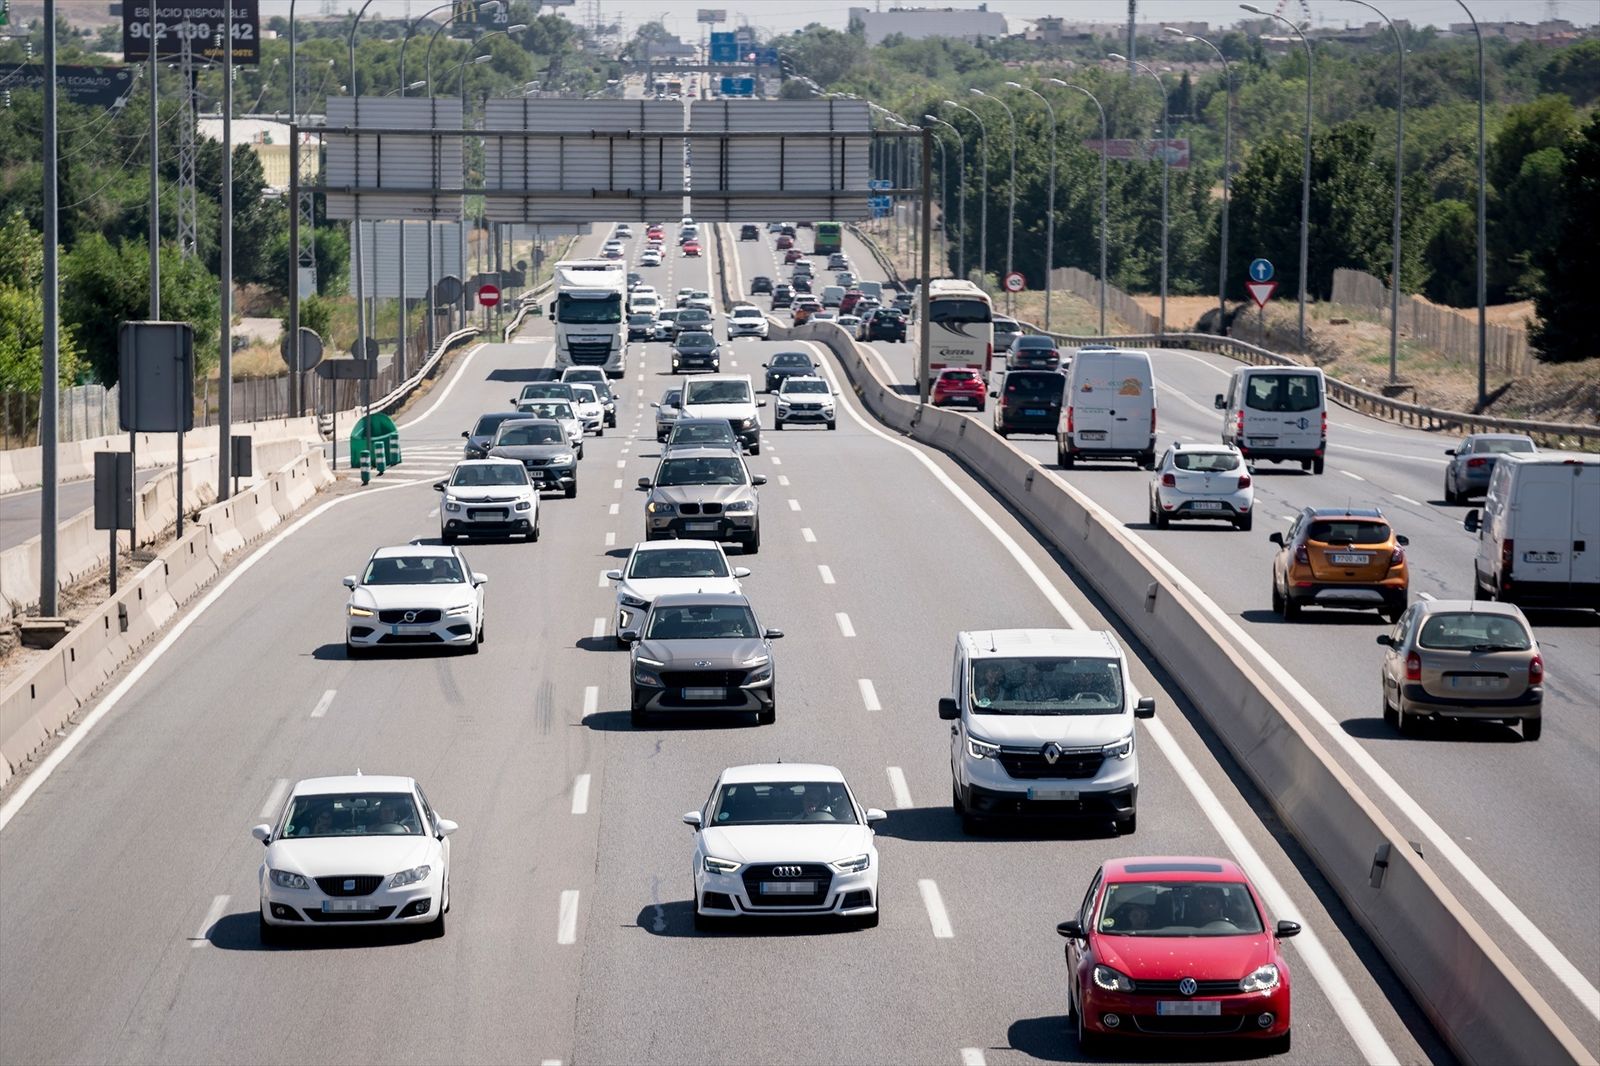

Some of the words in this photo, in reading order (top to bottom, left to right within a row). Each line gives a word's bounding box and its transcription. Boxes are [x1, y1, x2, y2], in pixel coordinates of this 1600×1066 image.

[135, 7, 182, 18] ESACIO
[184, 7, 248, 18] DISPONBLE
[130, 22, 167, 39] 902
[176, 23, 210, 39] 100
[217, 23, 254, 40] 542
